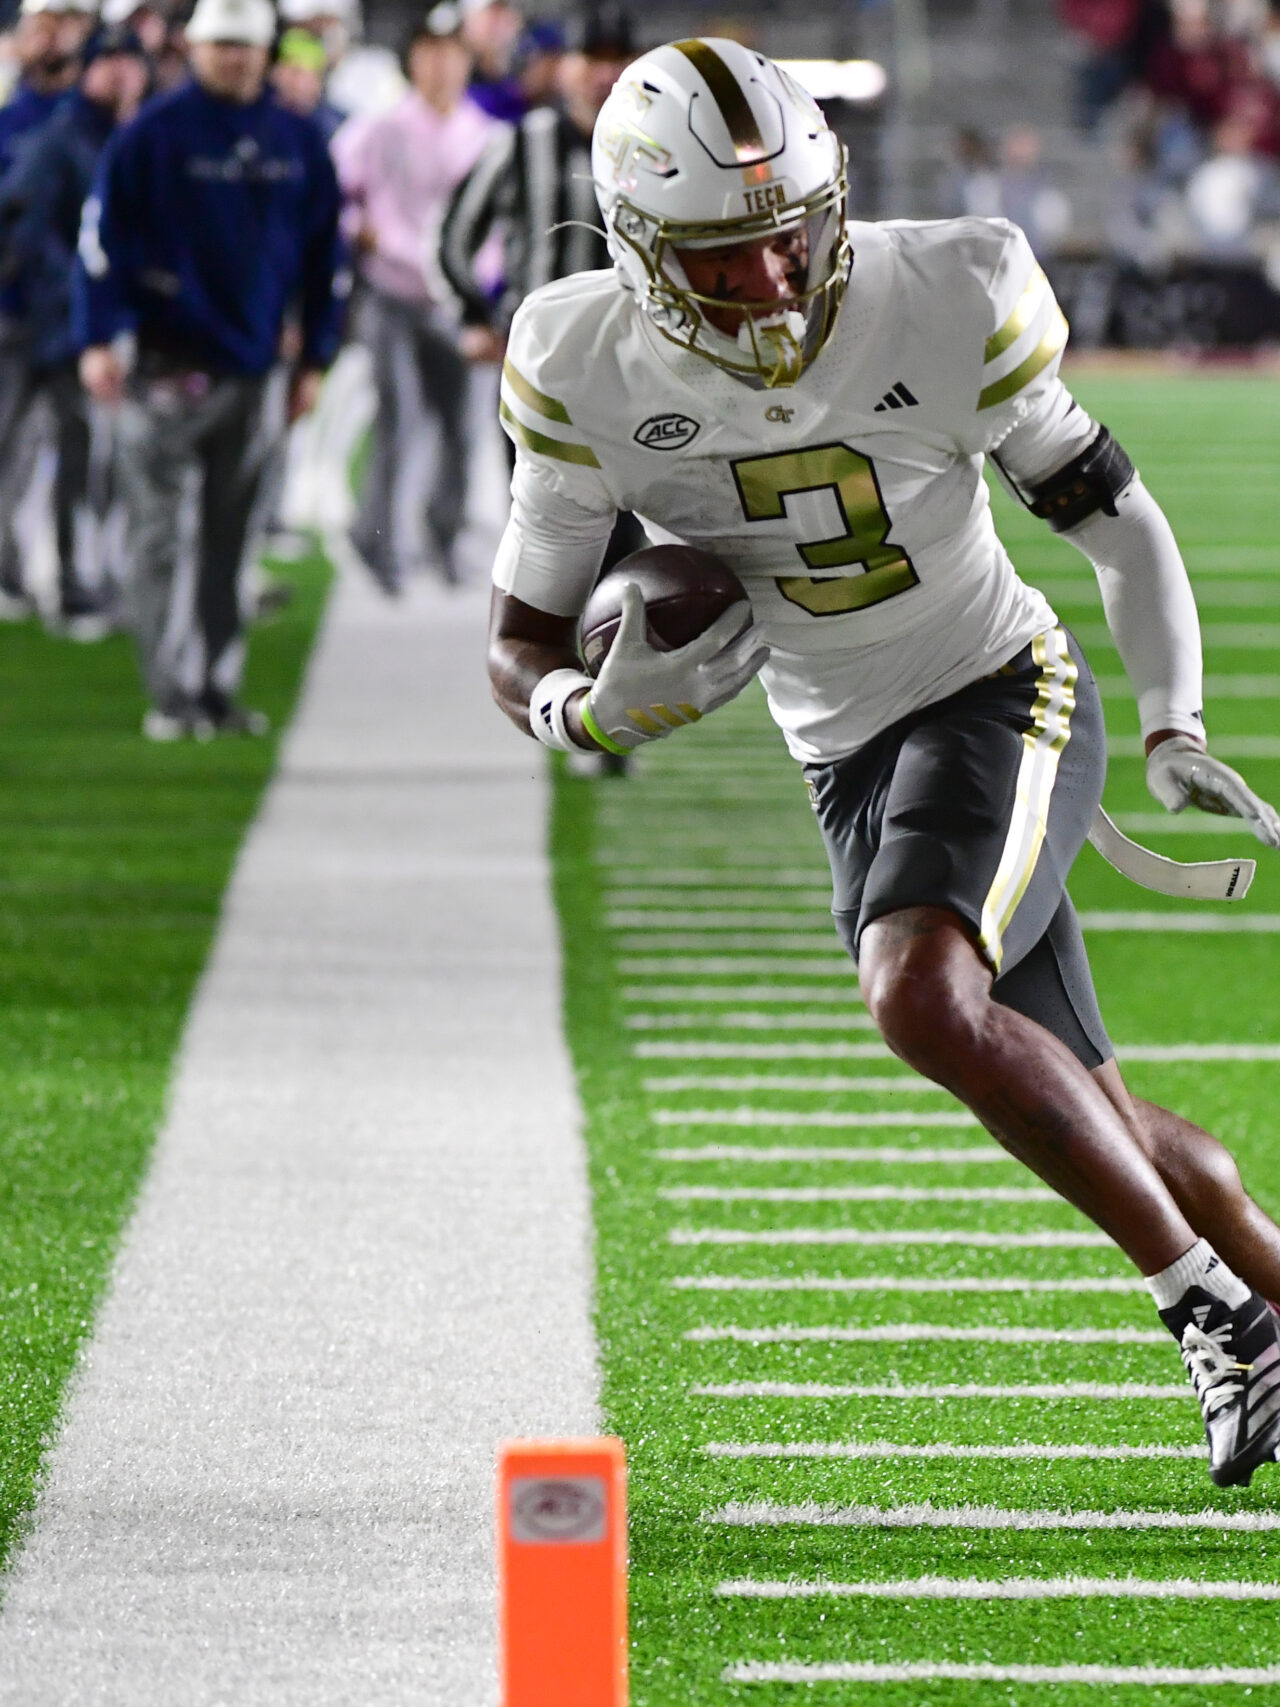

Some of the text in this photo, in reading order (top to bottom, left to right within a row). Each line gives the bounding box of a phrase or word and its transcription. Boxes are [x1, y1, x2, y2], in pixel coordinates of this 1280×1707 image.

[743, 184, 787, 213] TECH
[645, 419, 689, 441] ACC
[730, 442, 919, 616] 3
